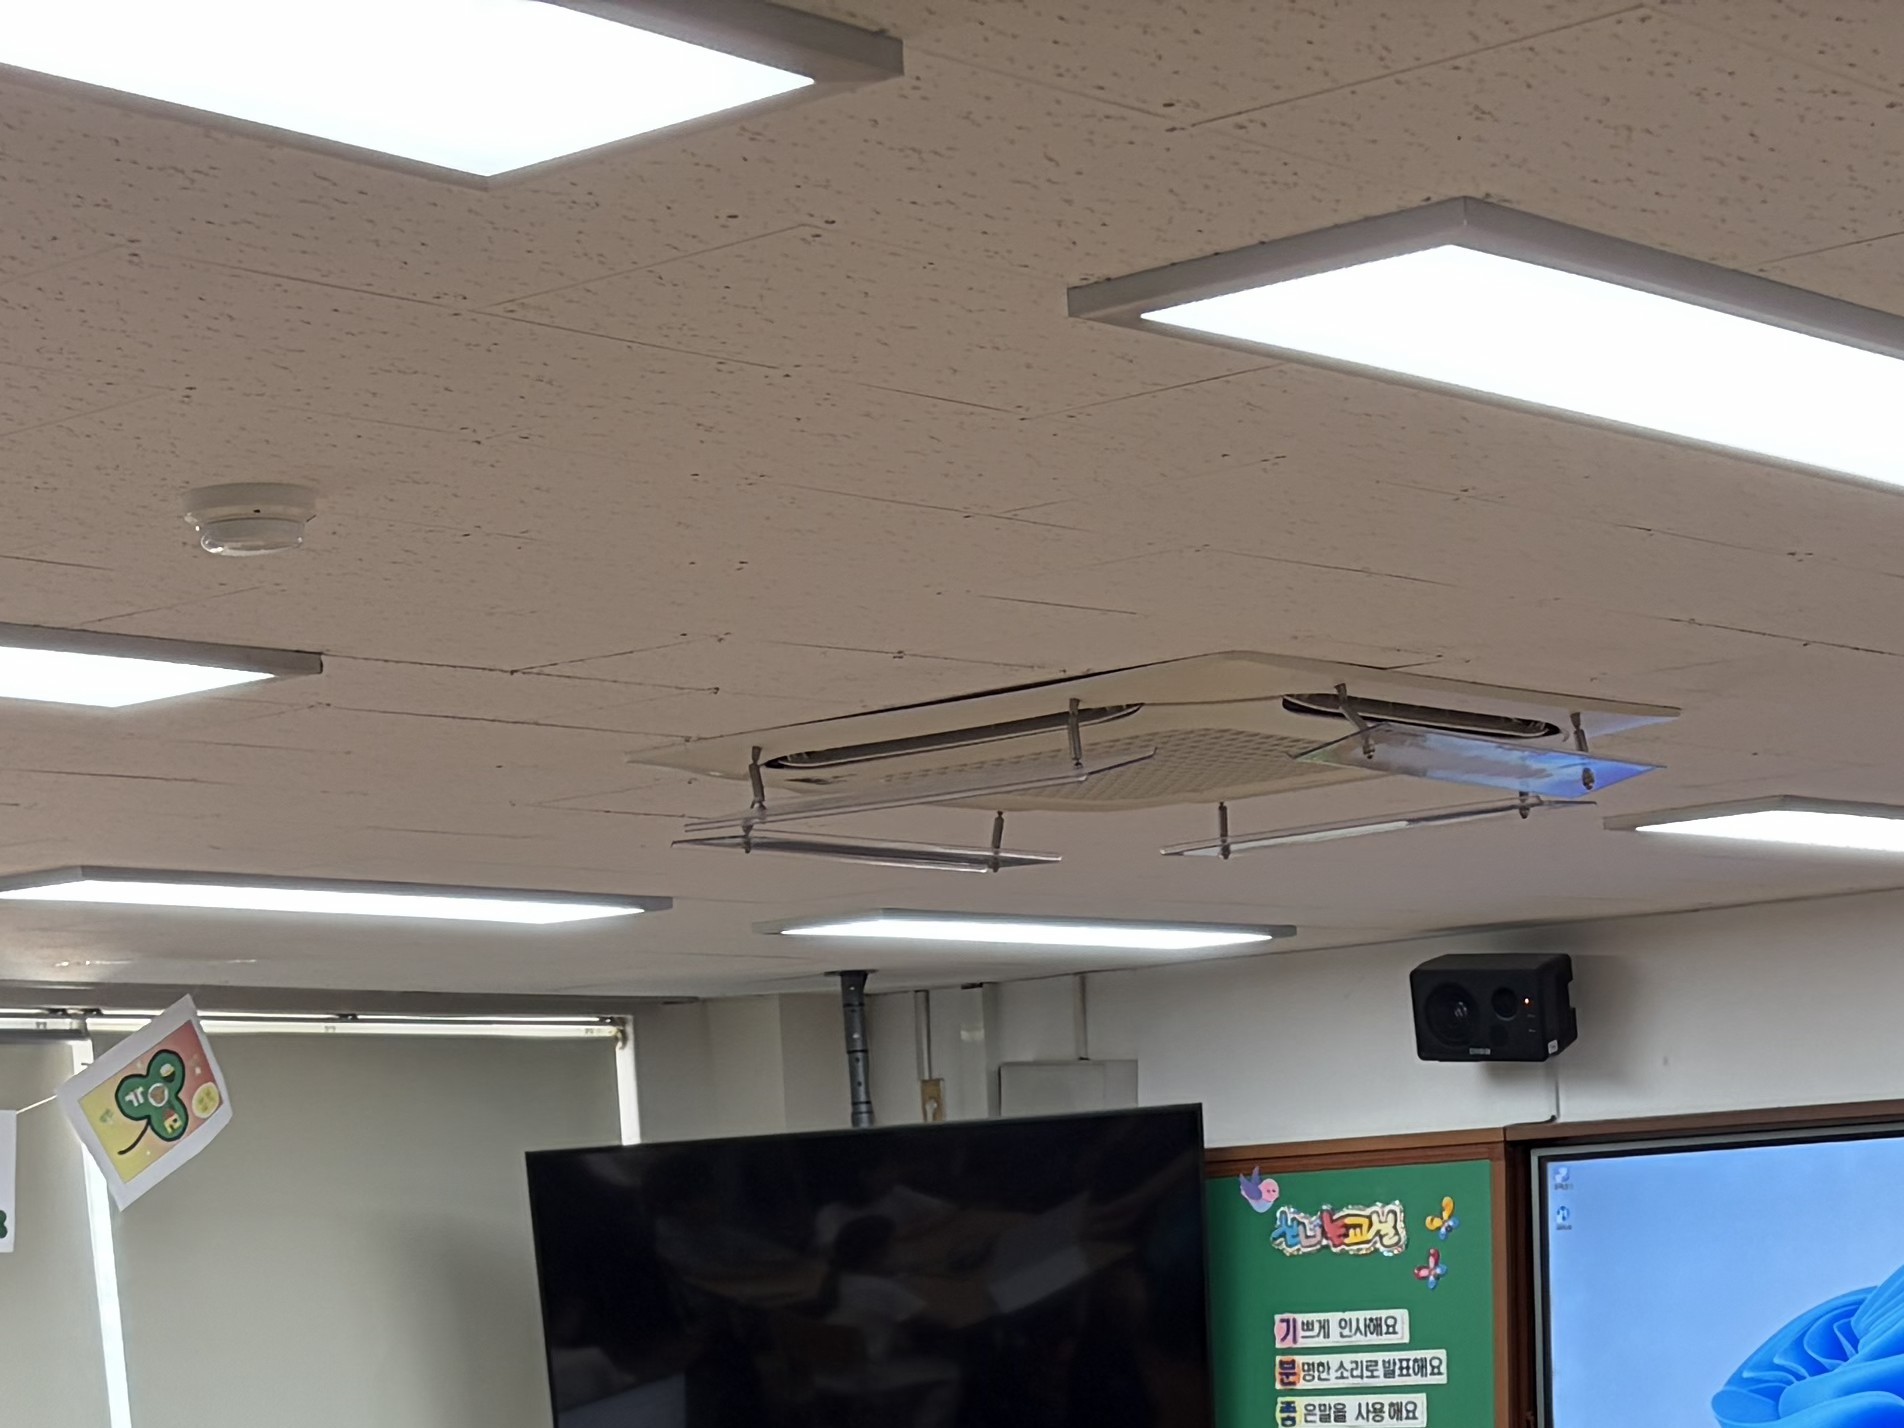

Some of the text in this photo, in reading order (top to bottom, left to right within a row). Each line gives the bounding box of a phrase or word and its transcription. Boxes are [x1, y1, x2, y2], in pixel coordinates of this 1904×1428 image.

[1279, 1314, 1399, 1344] 기쁘게 인사해요
[1278, 1359, 1331, 1386] 분명한
[1354, 1399, 1419, 1424] 사용해요
